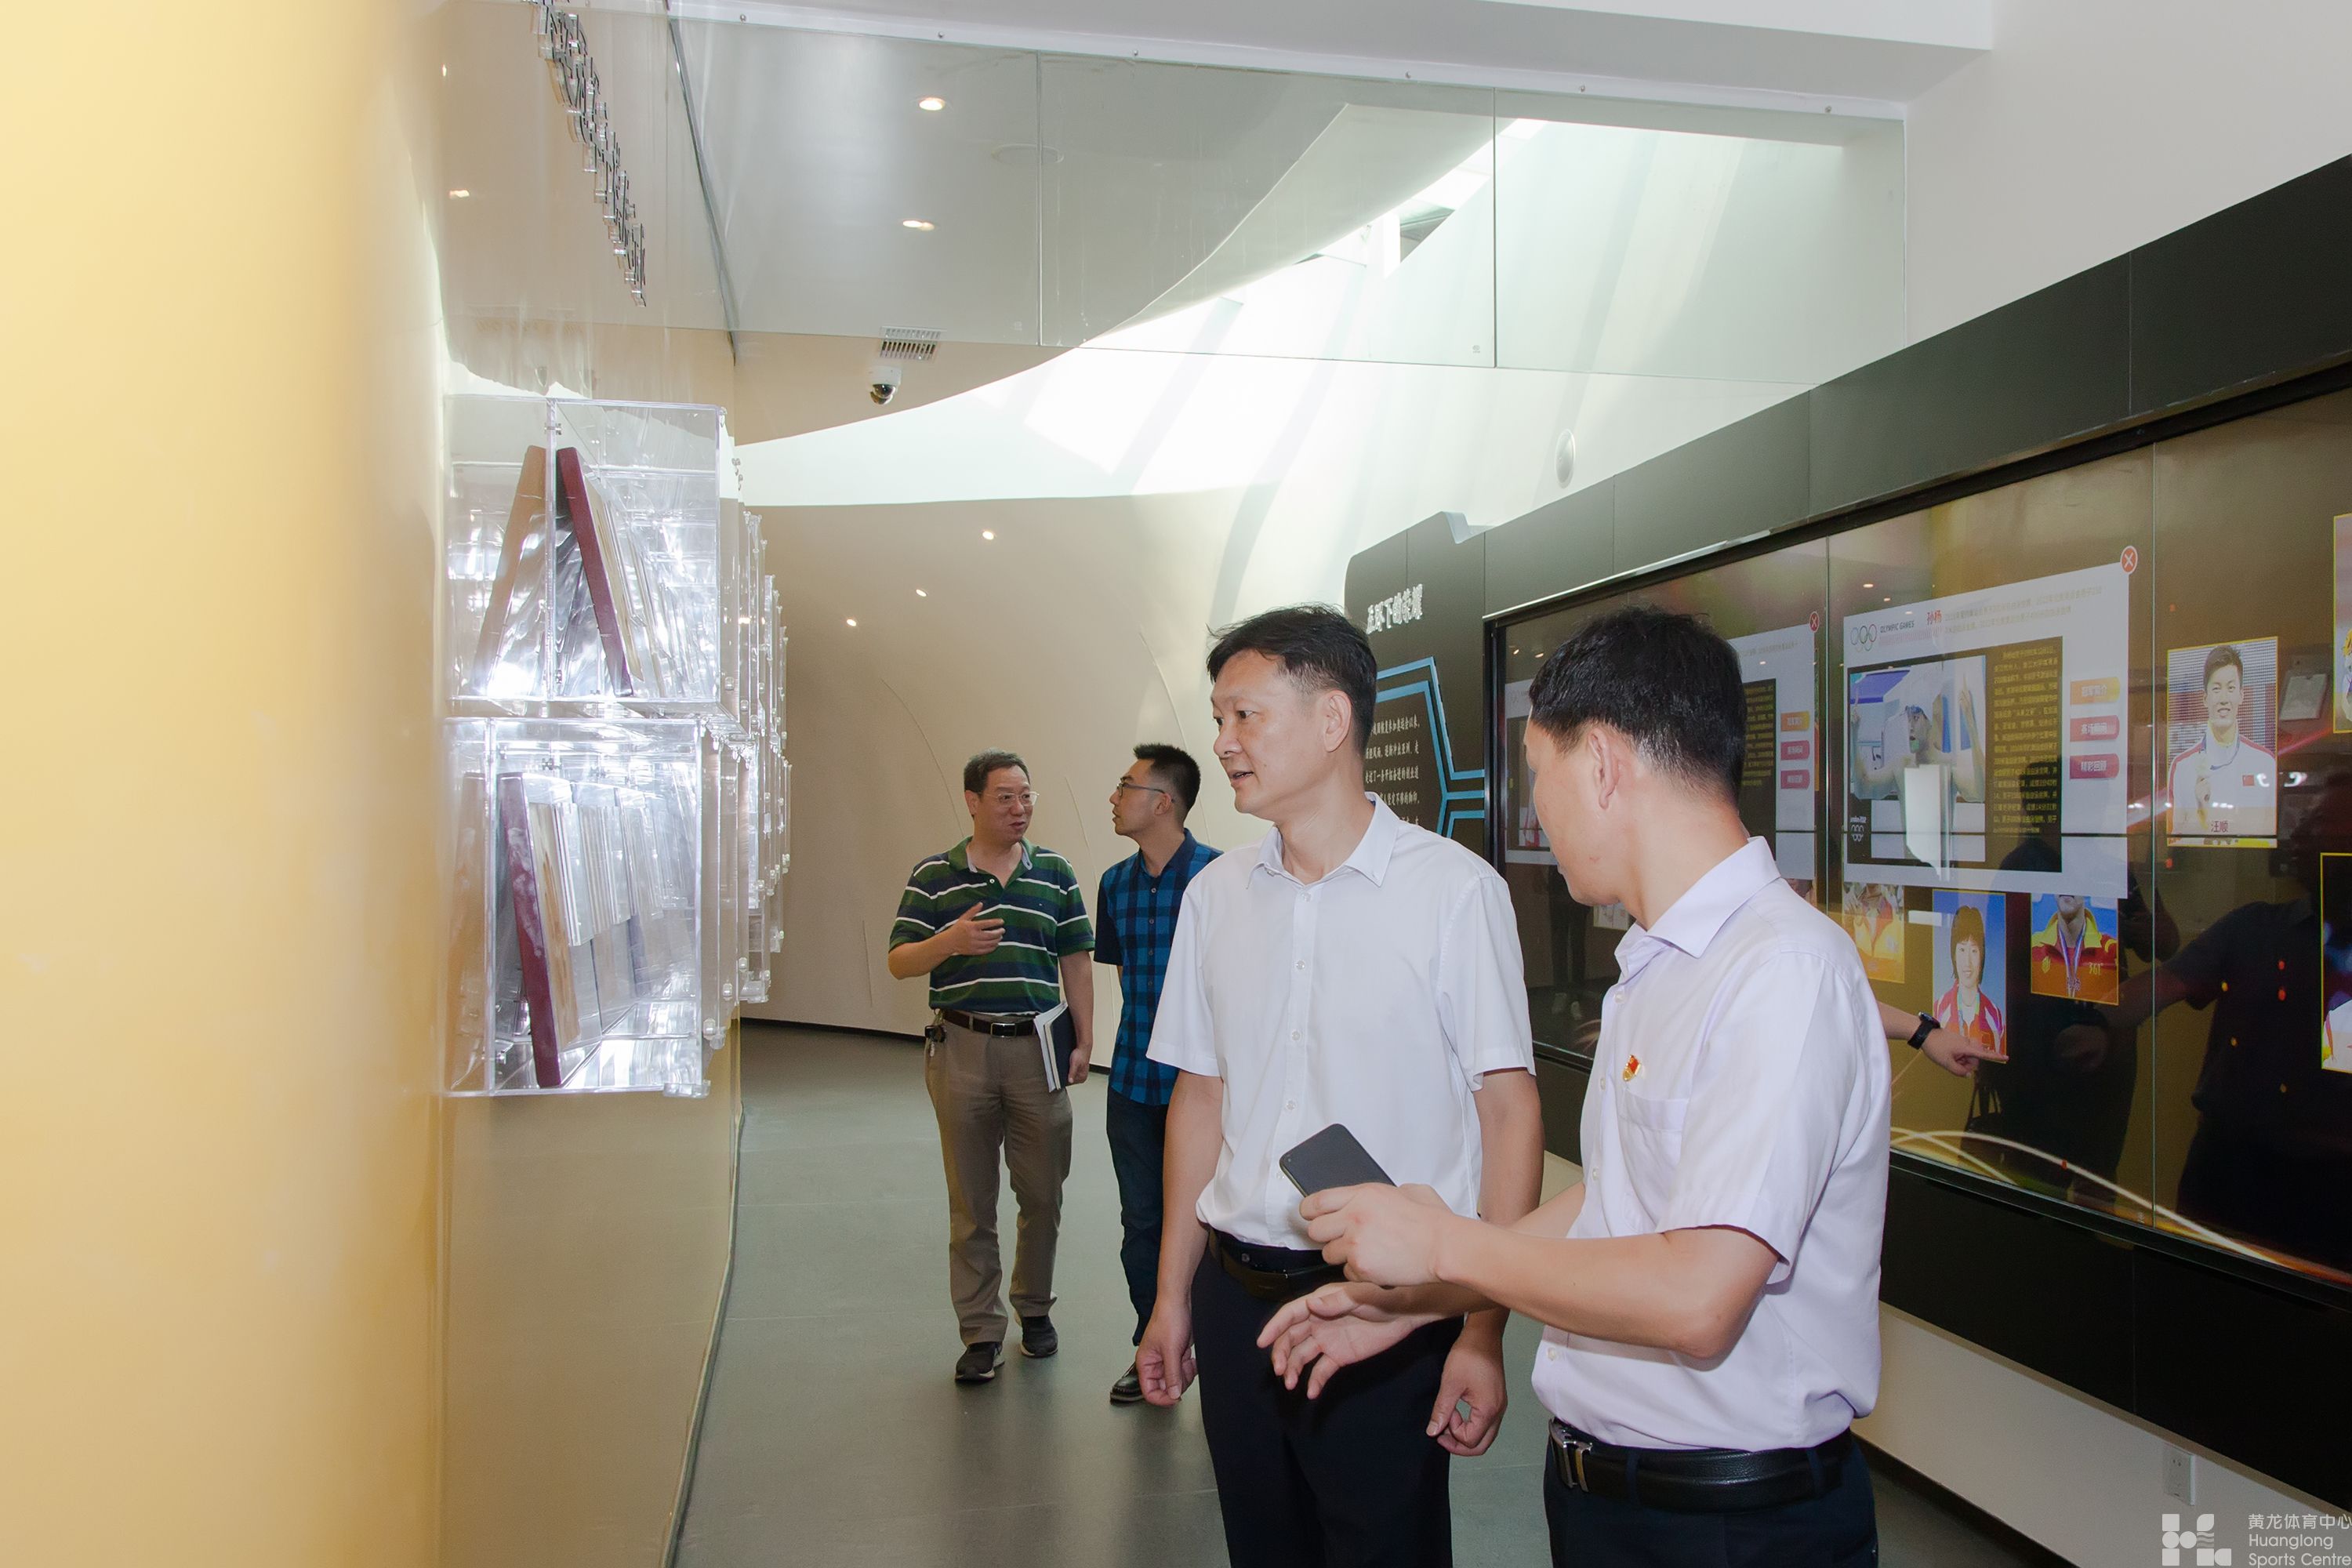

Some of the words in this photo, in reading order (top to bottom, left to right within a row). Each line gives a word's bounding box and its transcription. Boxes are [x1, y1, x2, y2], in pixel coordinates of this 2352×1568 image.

[1367, 584, 1423, 634] 五环下的荣耀
[1927, 610, 1942, 625] 孙杨
[1900, 620, 1915, 630] GAMES
[2211, 821, 2228, 832] 汪顺
